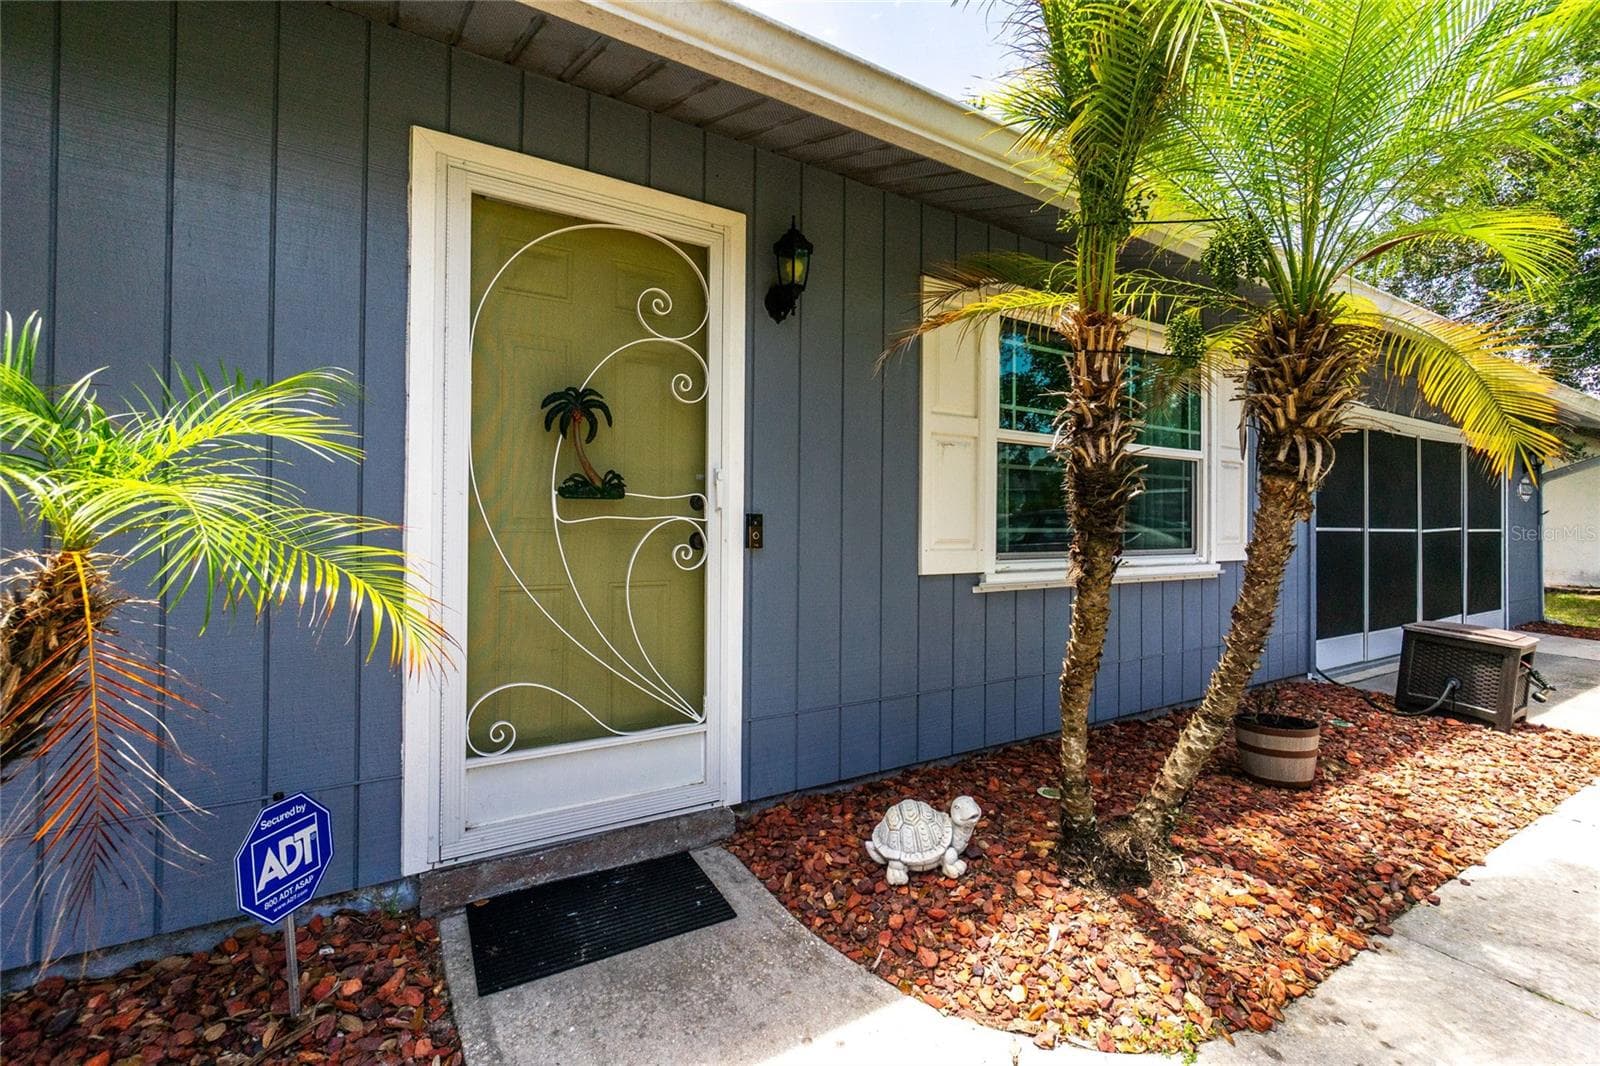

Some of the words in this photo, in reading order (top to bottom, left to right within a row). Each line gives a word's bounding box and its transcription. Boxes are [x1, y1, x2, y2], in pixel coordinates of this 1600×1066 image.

[260, 807, 296, 831] Secured
[296, 803, 307, 815] by
[256, 823, 318, 893] ADT
